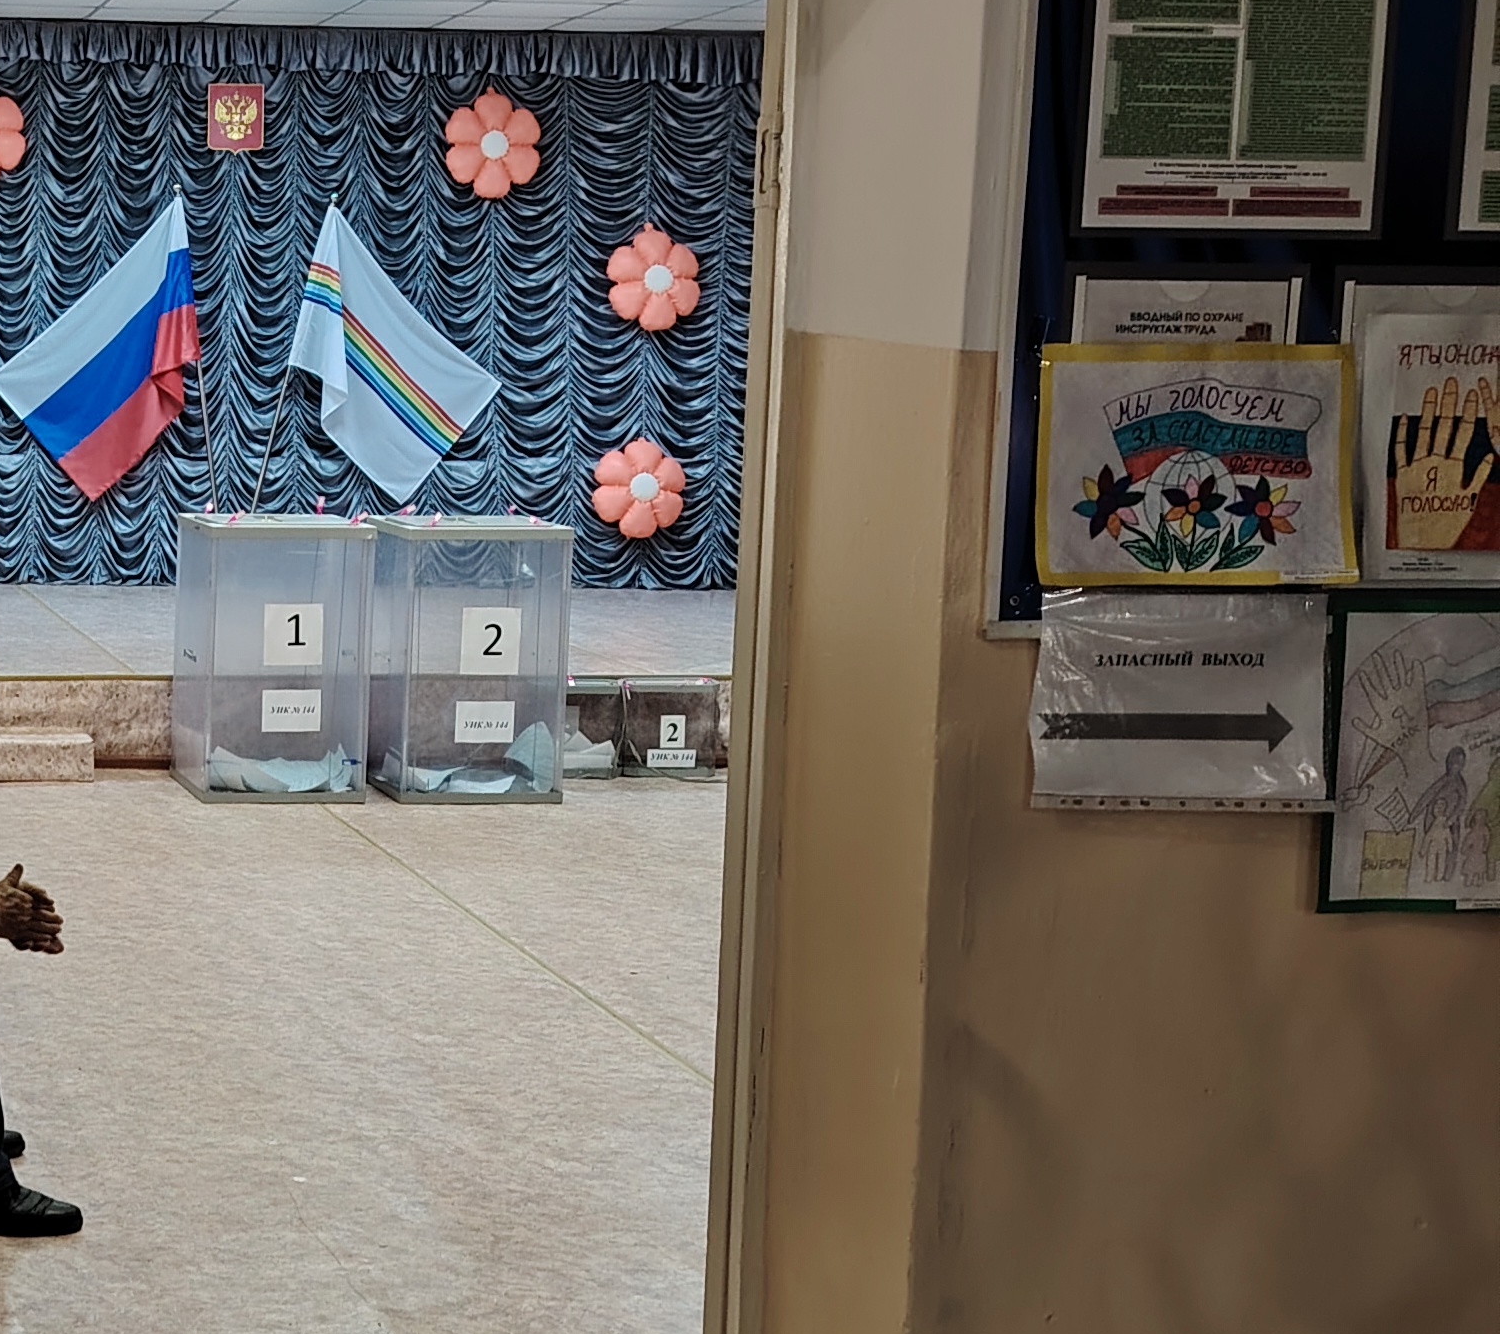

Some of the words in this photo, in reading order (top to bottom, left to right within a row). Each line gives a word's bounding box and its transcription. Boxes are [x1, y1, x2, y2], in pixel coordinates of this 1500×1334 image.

[1130, 311, 1183, 322] ВВОДНЫЙ
[1185, 313, 1200, 322] ПО
[1203, 312, 1244, 322] ОХРАНЕ
[1115, 324, 1182, 334] ИНСТРУКТАЖ
[1184, 325, 1216, 335] ТРУДА
[1115, 394, 1152, 426] МЫ
[1132, 427, 1161, 448] ЗА
[1229, 455, 1307, 475] ДЕТСТВО
[1426, 466, 1438, 491] Я
[1401, 493, 1478, 513] ГОЛОСУЮ!
[287, 613, 306, 646] 1
[482, 623, 503, 656] 2
[1095, 651, 1193, 667] ЗАПАСНЫЙ
[1201, 652, 1265, 668] ВЫХОД
[270, 705, 290, 714] УИК
[300, 705, 316, 714] 144
[463, 720, 483, 729] УИК
[494, 720, 509, 729] 144
[666, 723, 679, 742] 2
[650, 753, 670, 761] УИК
[681, 753, 694, 761] 144
